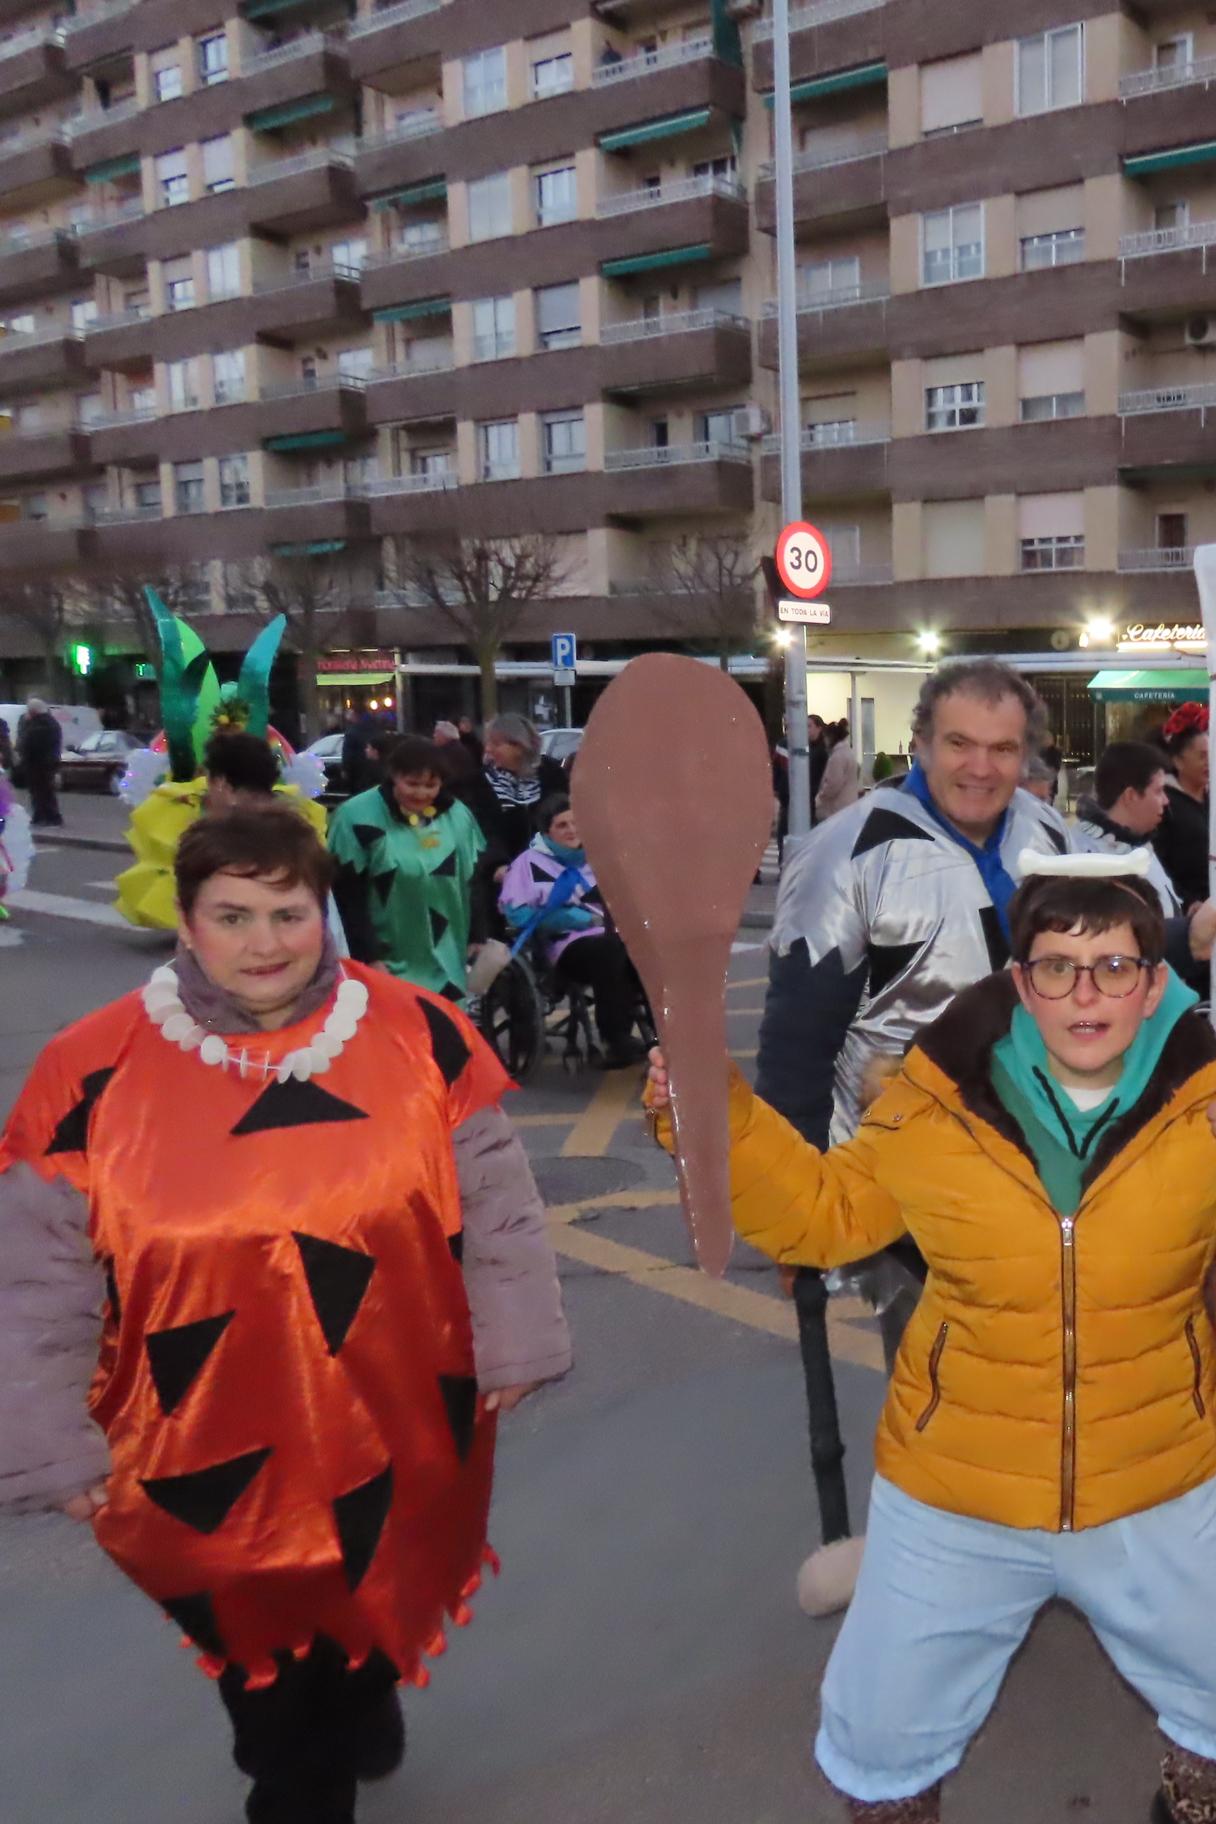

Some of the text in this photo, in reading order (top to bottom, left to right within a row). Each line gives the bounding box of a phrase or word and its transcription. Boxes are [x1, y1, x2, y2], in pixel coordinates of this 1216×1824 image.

[790, 546, 818, 573] 30
[791, 608, 808, 616] TODA
[810, 609, 818, 617] LA
[556, 638, 570, 665] P
